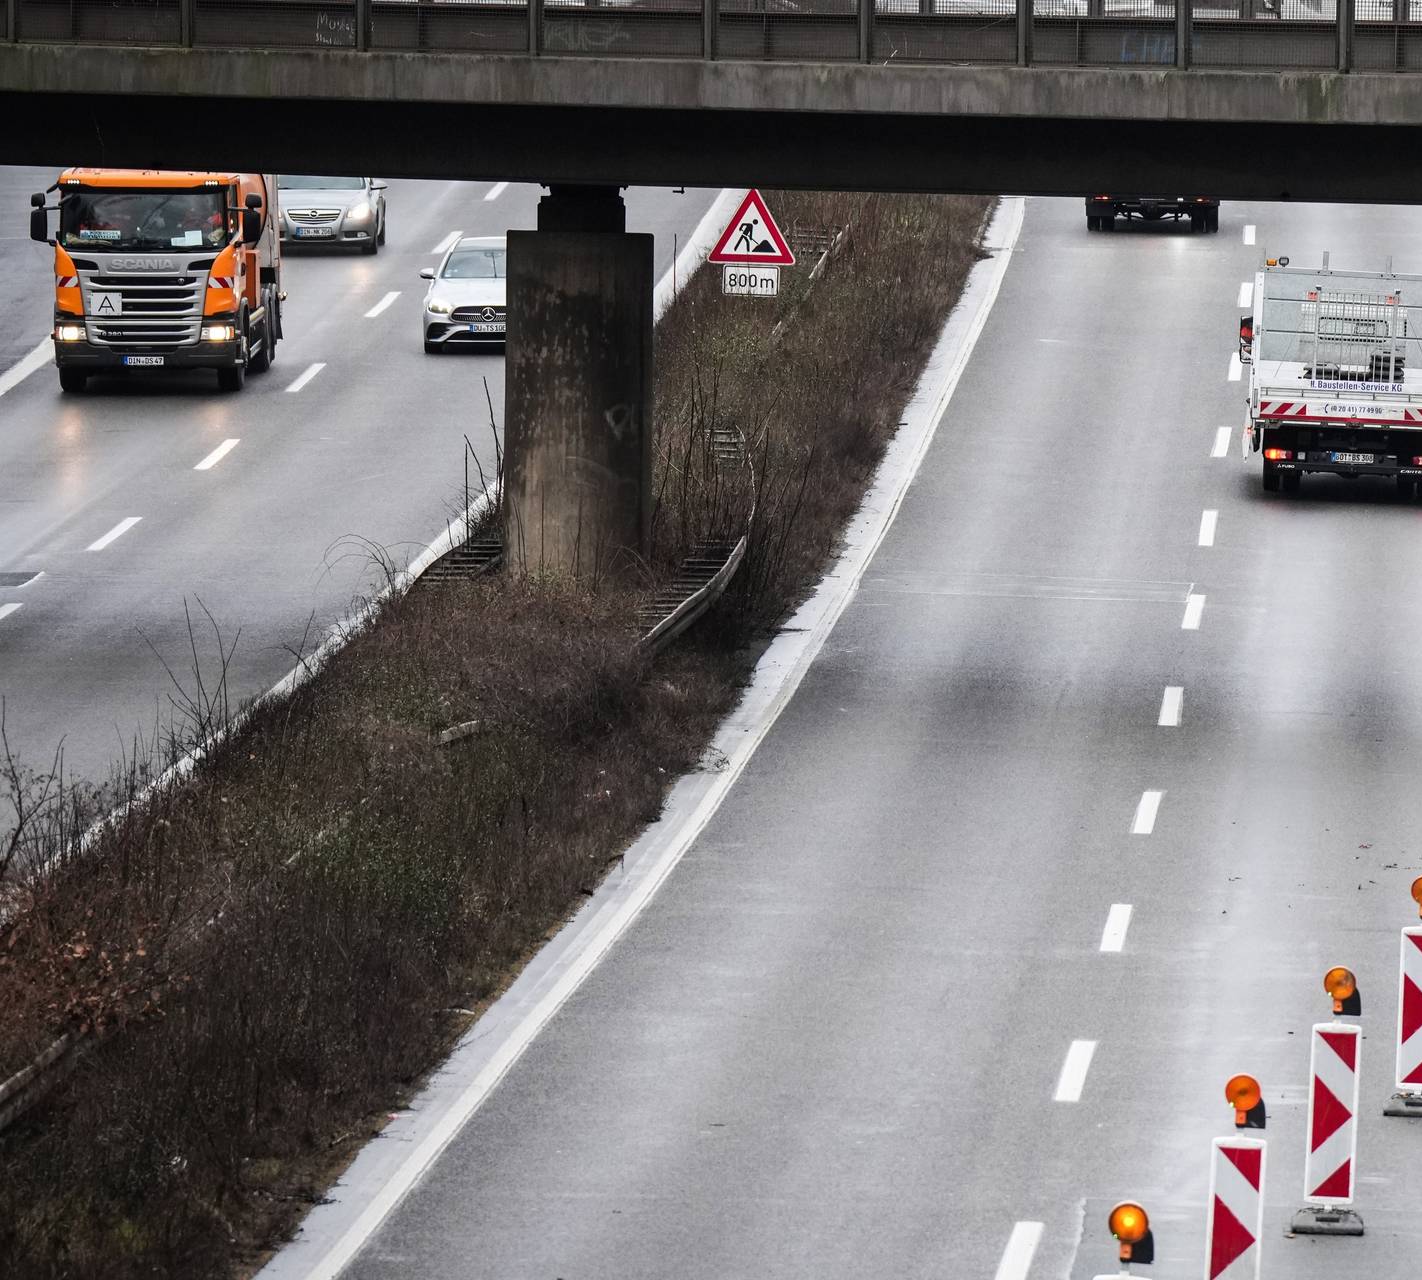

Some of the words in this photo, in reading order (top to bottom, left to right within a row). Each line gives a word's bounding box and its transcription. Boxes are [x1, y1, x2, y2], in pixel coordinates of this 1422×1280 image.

[111, 259, 174, 270] SCANIA
[97, 295, 115, 312] A
[1391, 384, 1403, 392] KG
